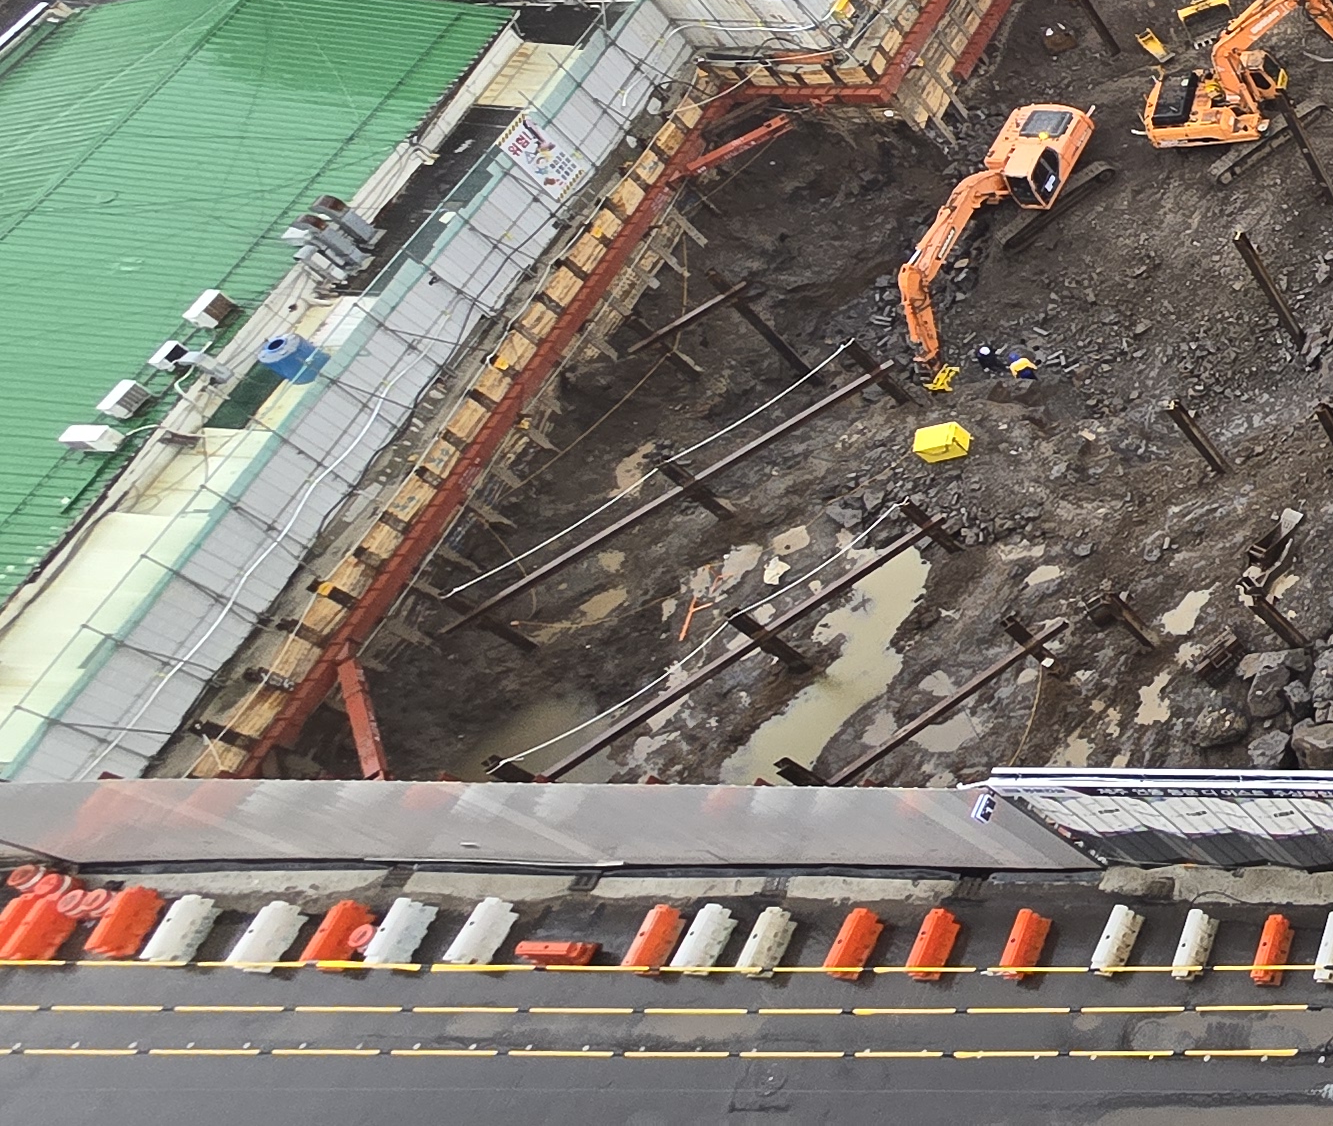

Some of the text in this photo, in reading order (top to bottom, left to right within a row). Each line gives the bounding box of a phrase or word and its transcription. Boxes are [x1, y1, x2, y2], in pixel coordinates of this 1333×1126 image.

[507, 131, 534, 157] 위험!
[1097, 788, 1128, 796] 제주
[1221, 789, 1268, 797] 이스트
